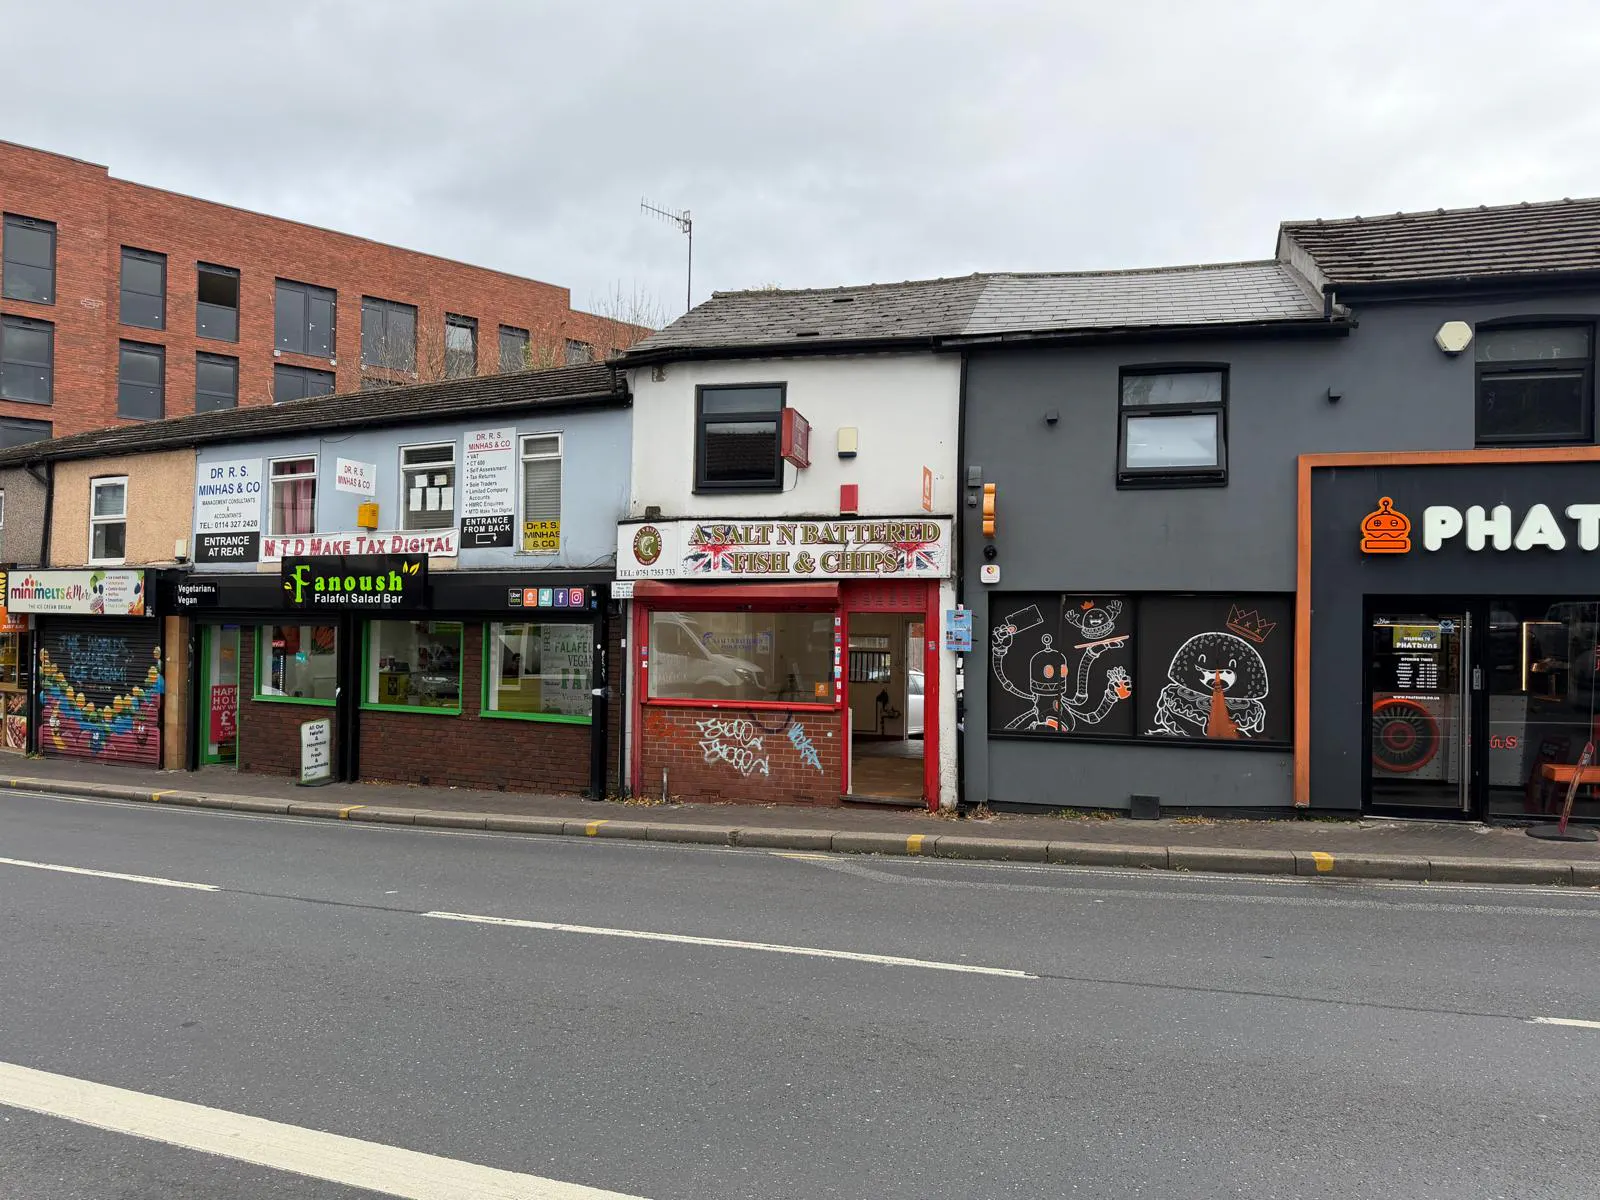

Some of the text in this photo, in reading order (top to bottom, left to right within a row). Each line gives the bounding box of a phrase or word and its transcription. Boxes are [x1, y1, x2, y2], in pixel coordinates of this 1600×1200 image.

[468, 442, 493, 450] MINHAS
[210, 468, 223, 479] DR
[199, 482, 260, 496] MINHAS & CO
[358, 479, 361, 488] &
[362, 480, 370, 489] CO
[466, 516, 508, 526] ENTRANCE
[688, 522, 941, 545] A SALT N BATTERED
[204, 536, 249, 546] ENTRANCE
[264, 535, 453, 557] M T D MAKE TAX DIGITAL
[208, 547, 244, 556] AT REAR
[731, 550, 900, 573] FISH & CHIPS
[178, 584, 211, 595] Vegetarian
[290, 565, 403, 603] Fanoush
[178, 595, 198, 606] Vegan
[314, 593, 403, 604] Falafel Salad Bar
[568, 654, 593, 667] VEGAN
[70, 665, 88, 678] ICE
